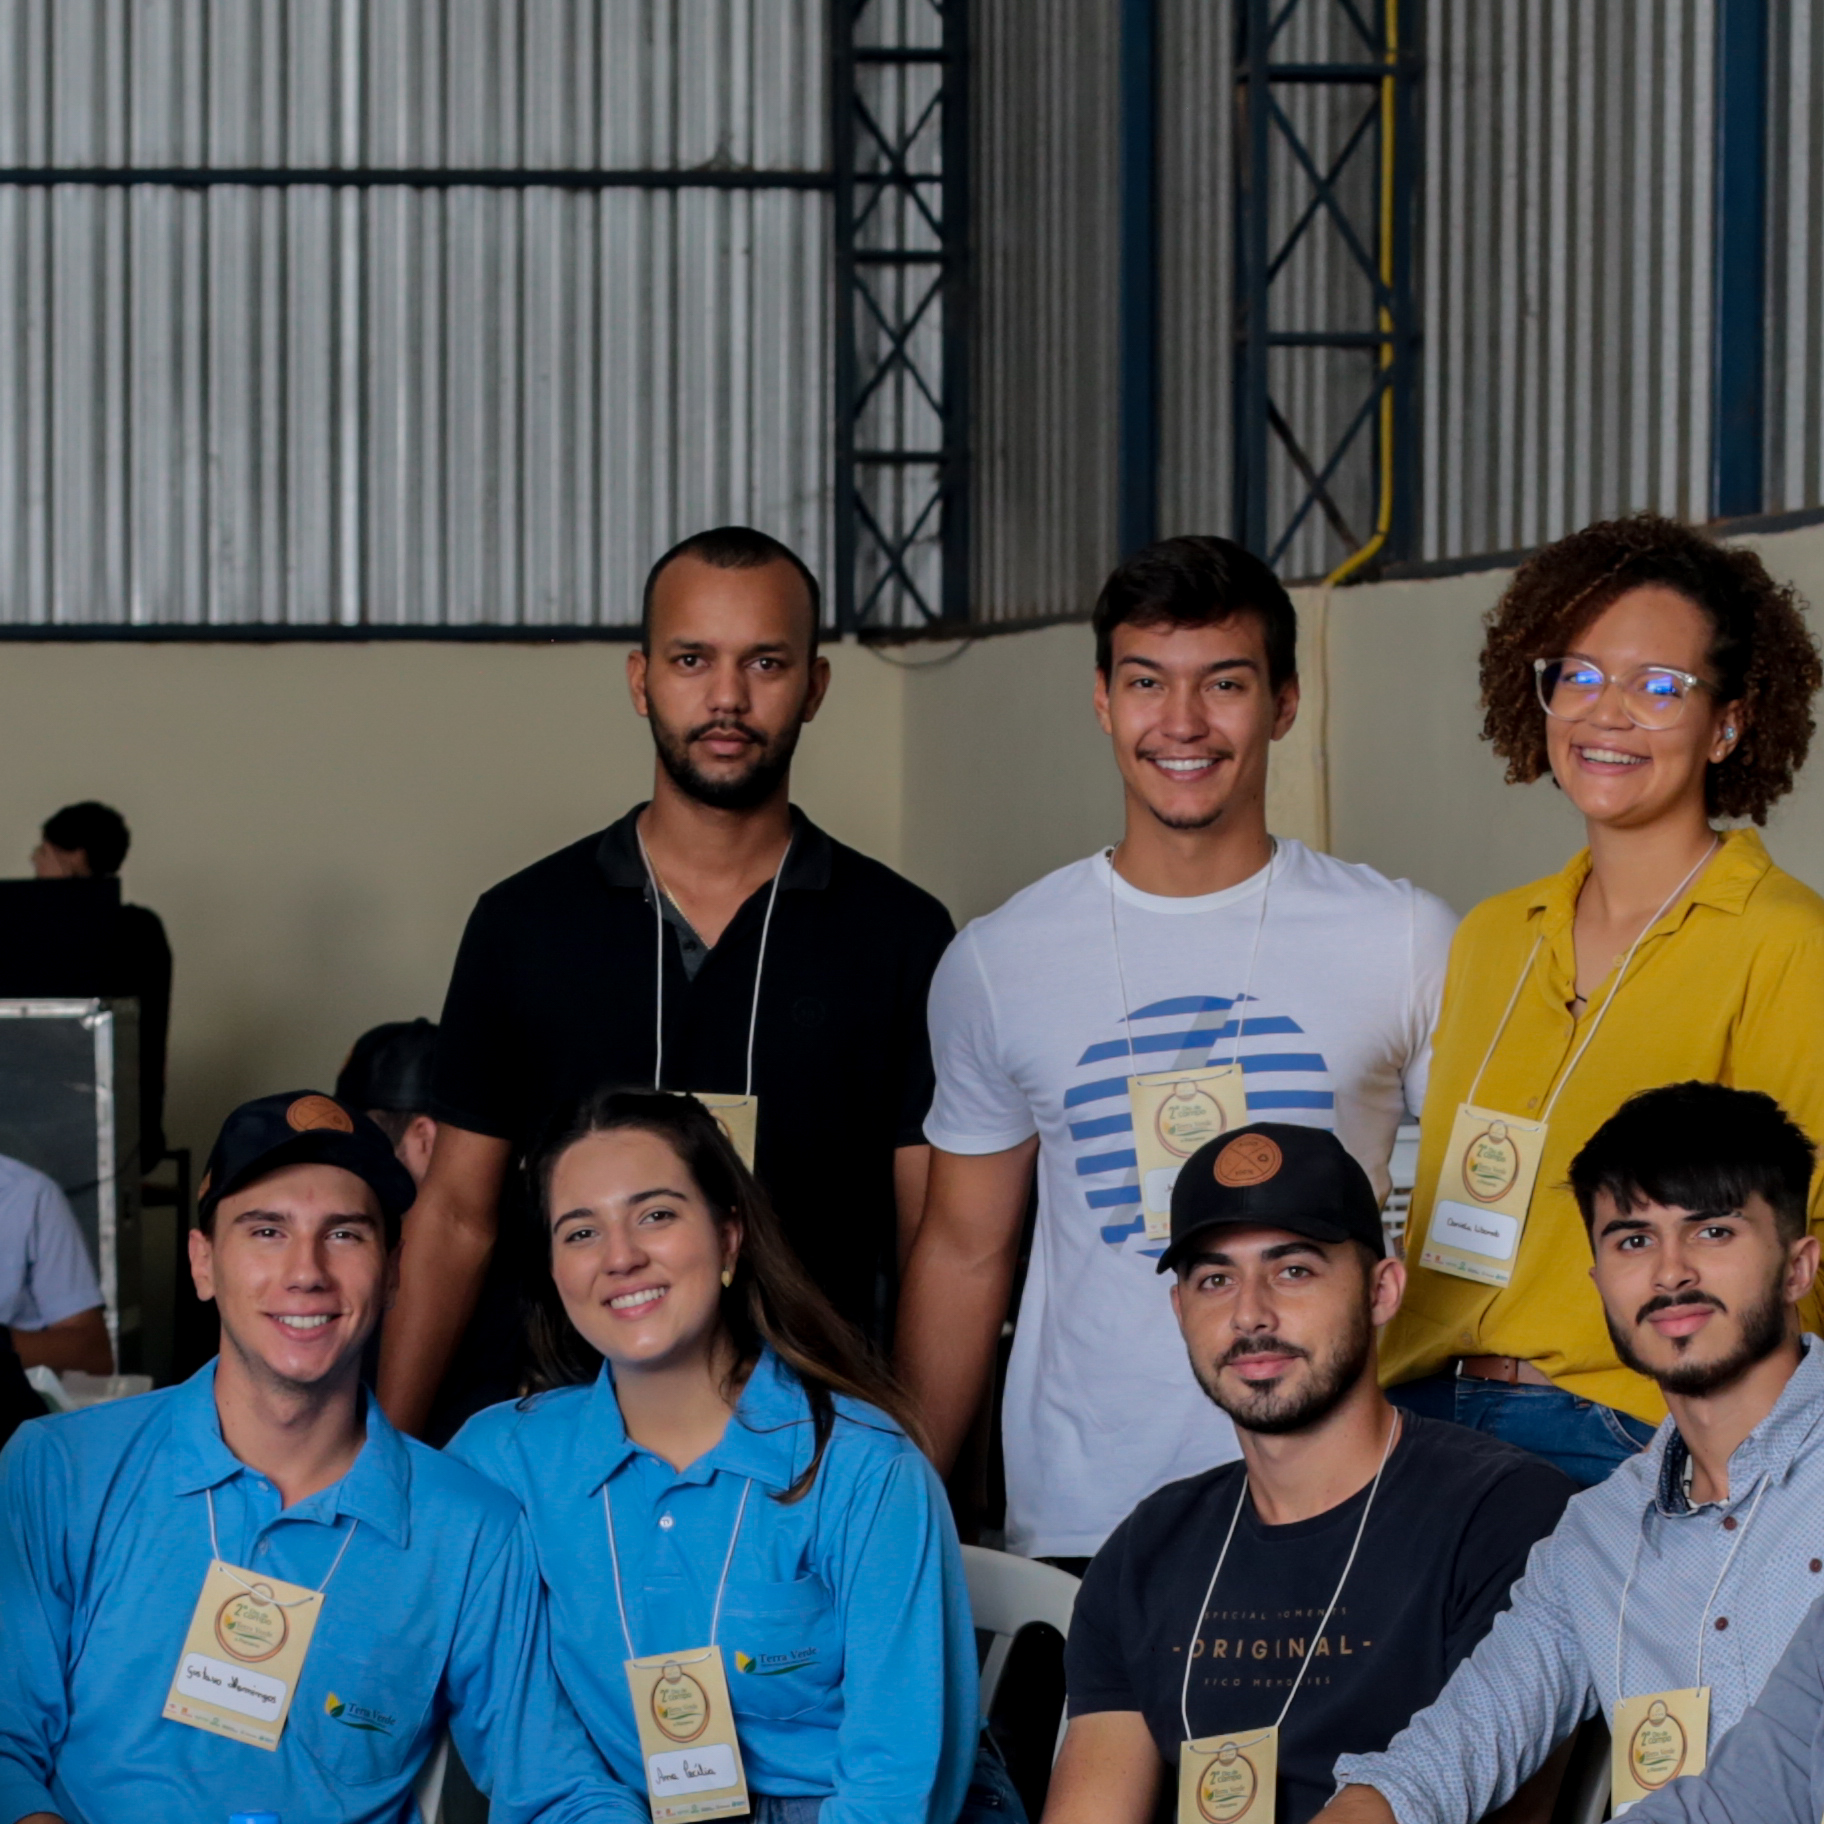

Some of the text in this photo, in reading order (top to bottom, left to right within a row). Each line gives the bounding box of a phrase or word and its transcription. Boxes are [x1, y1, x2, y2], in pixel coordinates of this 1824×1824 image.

[1204, 1611, 1266, 1620] SPECIAL
[759, 1653, 787, 1663] Terra
[791, 1647, 817, 1659] Verde
[348, 1702, 371, 1716] Terra
[373, 1709, 396, 1725] Verde
[656, 1767, 679, 1785] Ana
